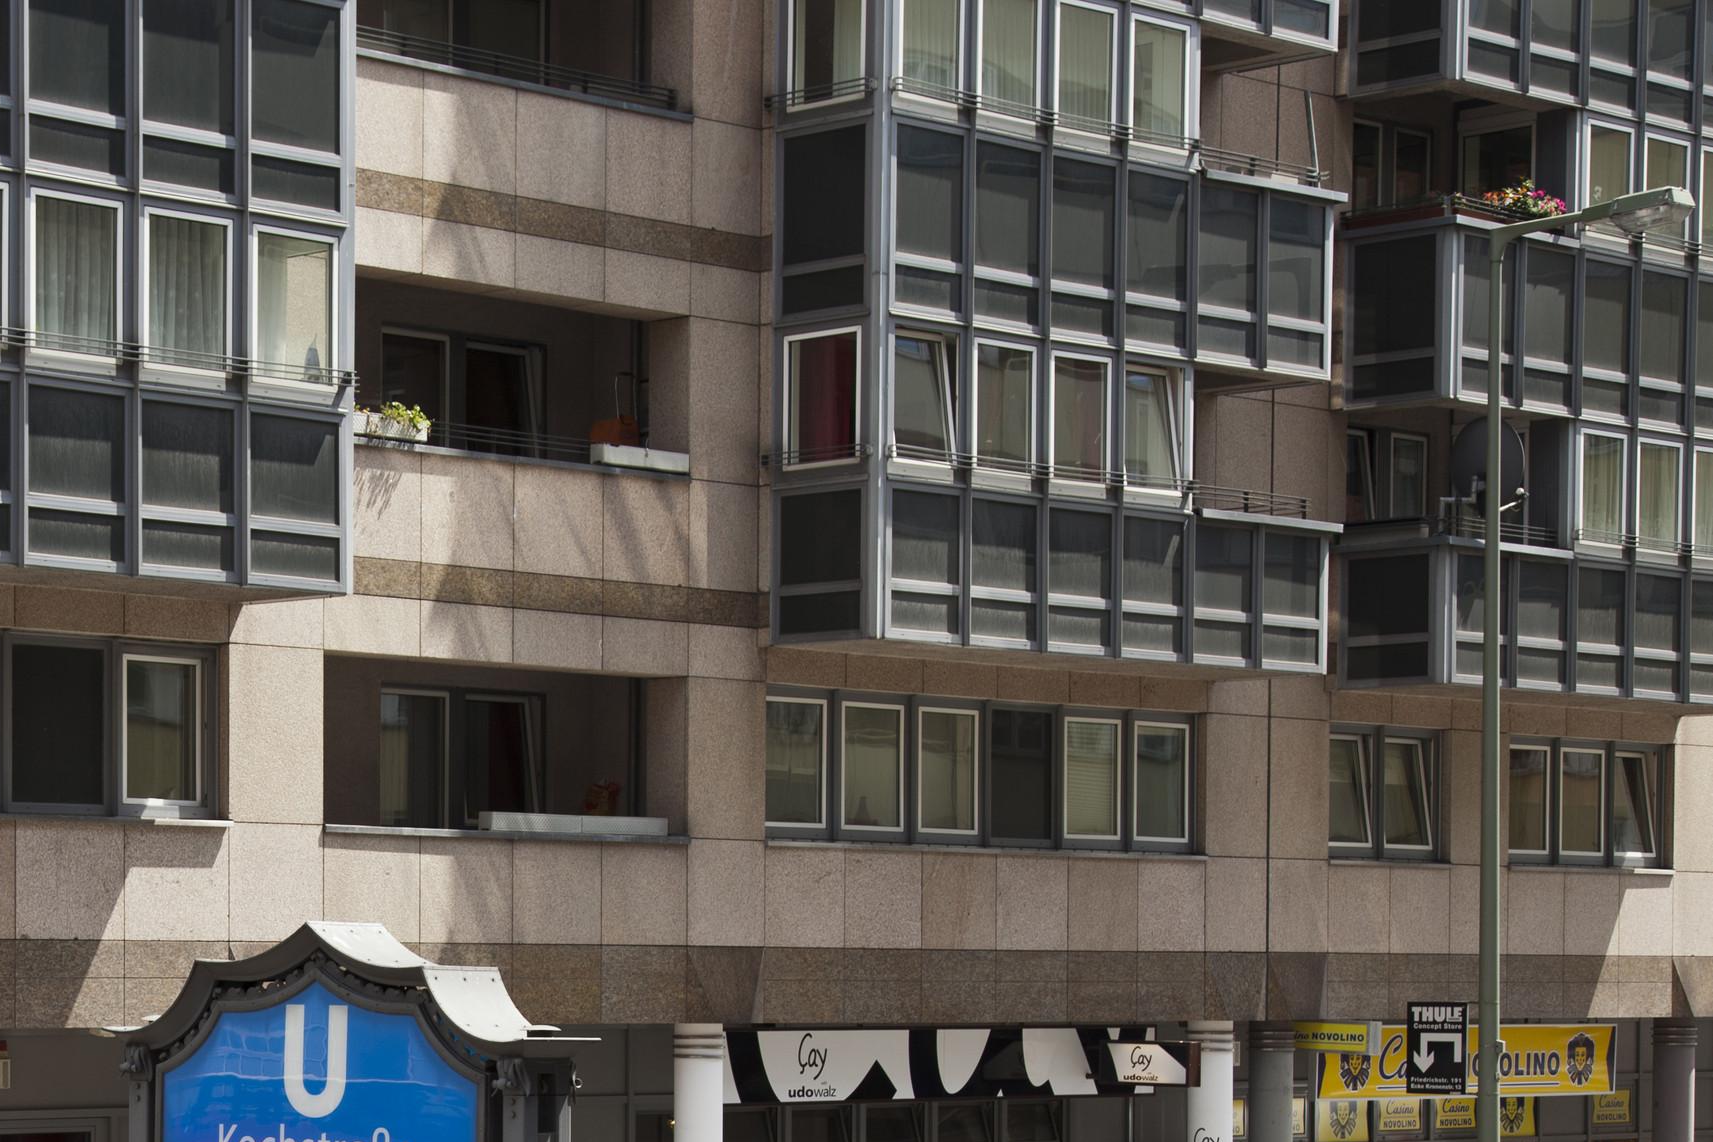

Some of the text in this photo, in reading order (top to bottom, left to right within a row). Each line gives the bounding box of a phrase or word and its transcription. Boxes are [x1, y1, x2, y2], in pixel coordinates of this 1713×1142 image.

[1411, 1006, 1462, 1022] THULE
[1413, 1022, 1442, 1030] Concept
[1311, 1031, 1365, 1042] NOVOLINO
[284, 1004, 348, 1118] U
[798, 1032, 828, 1080] Çay
[1130, 1045, 1153, 1072] Çay
[1123, 1073, 1159, 1082] udowalz
[787, 1085, 837, 1098] udowalz
[1442, 1098, 1470, 1113] Casino
[1383, 1119, 1417, 1128] NOVOLINO
[1439, 1118, 1472, 1127] NOVOLINO
